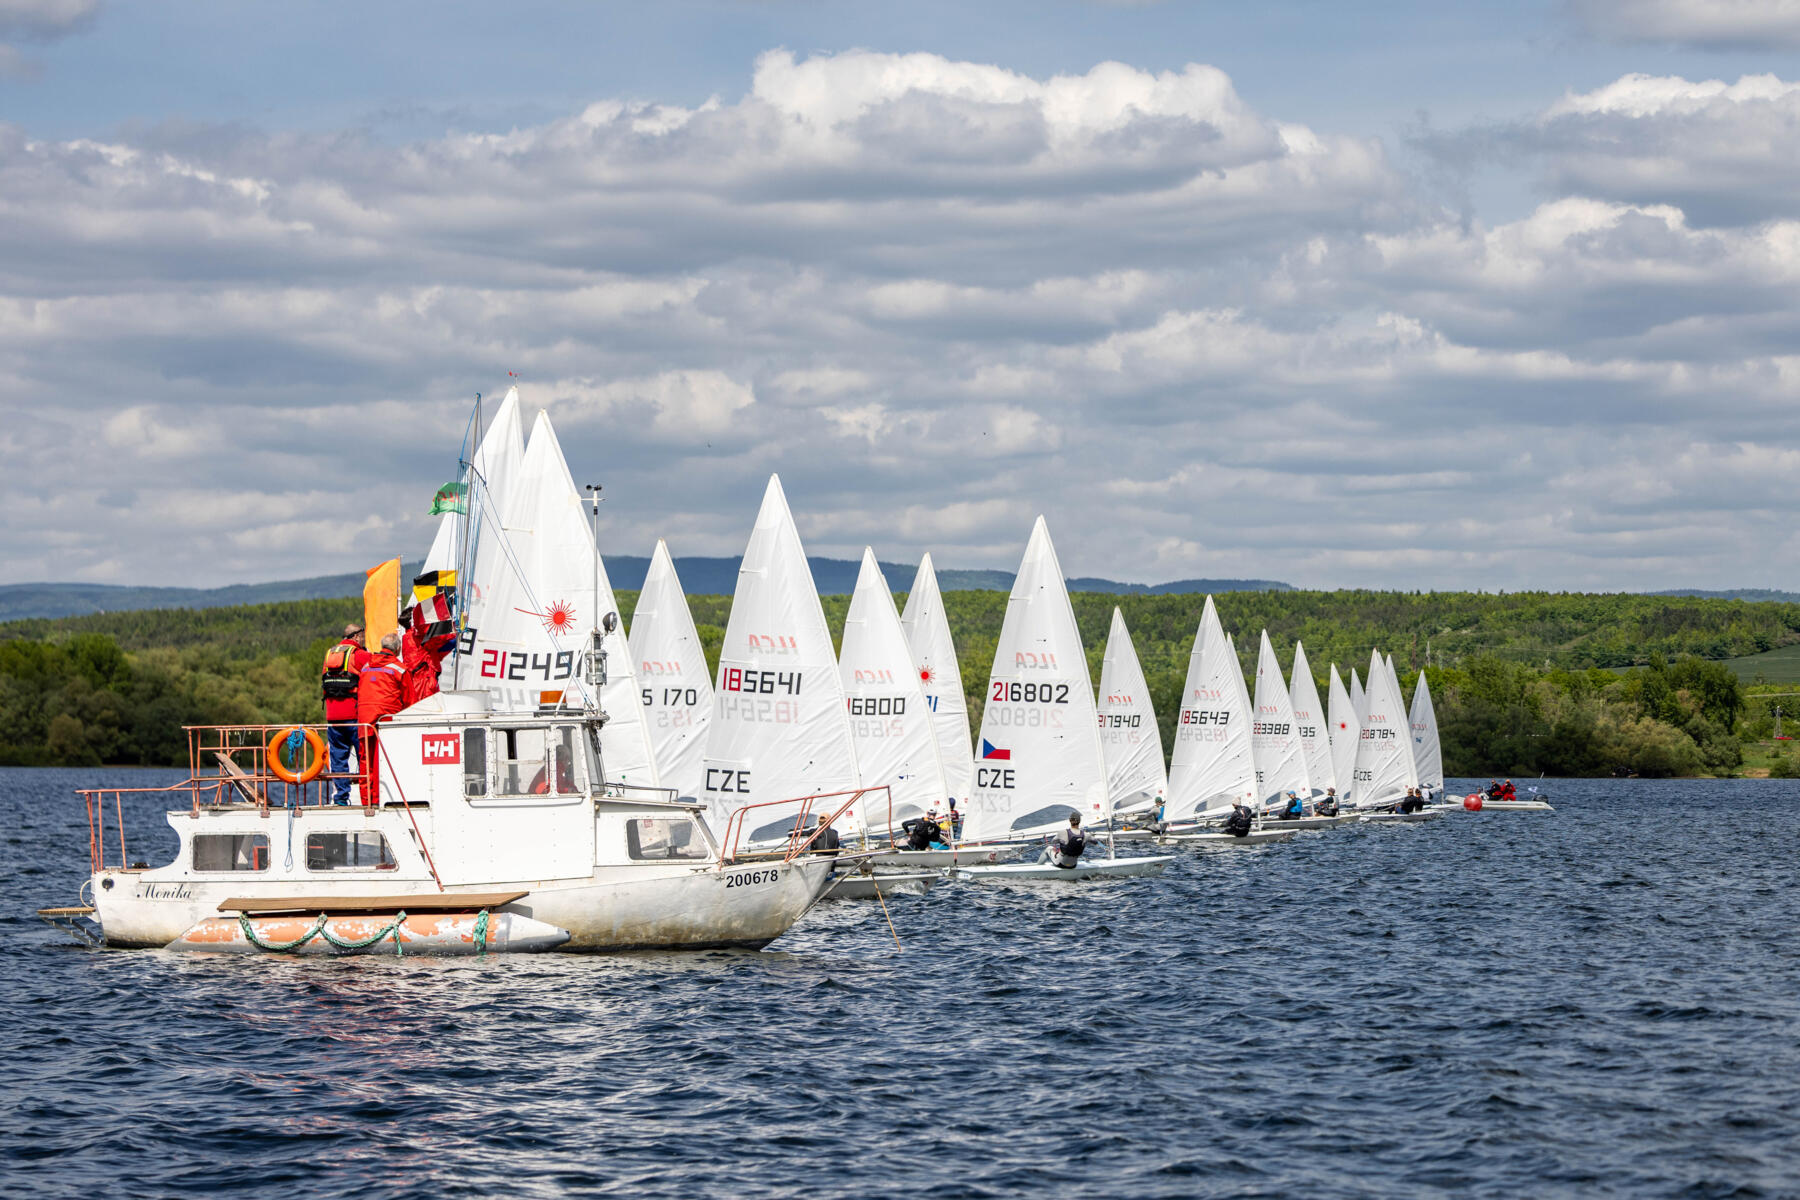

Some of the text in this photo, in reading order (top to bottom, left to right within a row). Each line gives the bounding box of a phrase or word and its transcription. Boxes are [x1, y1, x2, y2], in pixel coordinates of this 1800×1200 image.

[722, 667, 802, 695] 185641
[992, 681, 1069, 704] 216802
[1180, 710, 1230, 725] 185643
[1361, 729, 1396, 739] 208784
[706, 768, 750, 793] CZE
[978, 768, 1015, 789] CZE
[726, 869, 779, 888] 200678
[136, 883, 192, 899] Monika
